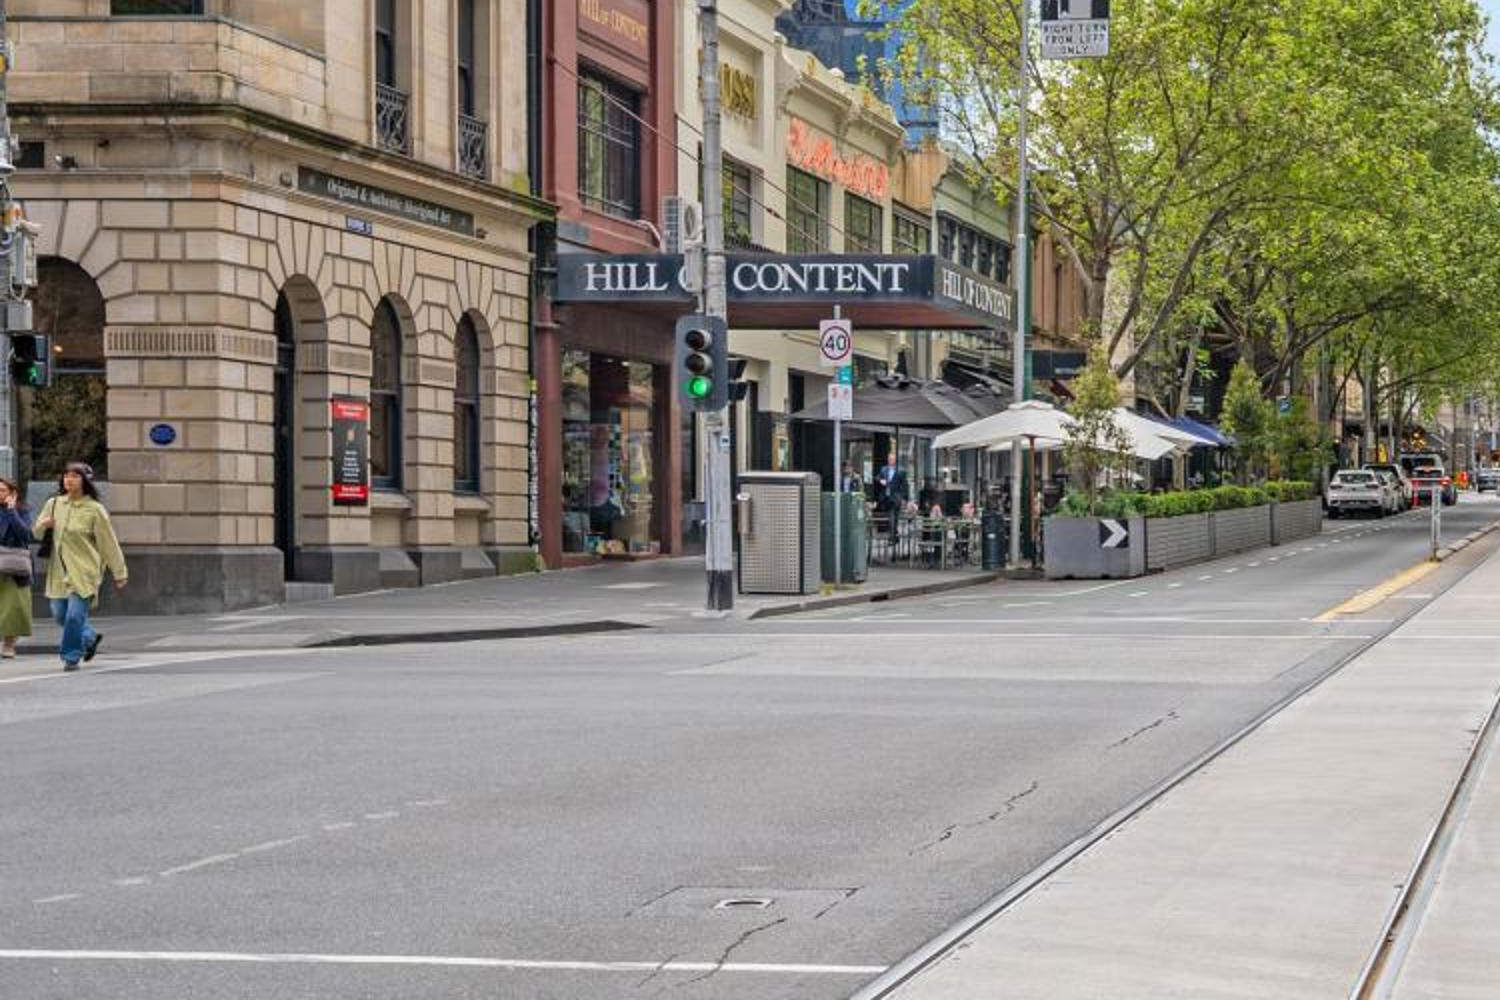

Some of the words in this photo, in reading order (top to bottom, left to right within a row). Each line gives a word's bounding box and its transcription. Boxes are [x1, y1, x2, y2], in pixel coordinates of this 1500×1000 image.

[1044, 24, 1073, 34] RIGHT
[1079, 23, 1107, 33] TURN
[1045, 34, 1073, 45] FROM
[1080, 33, 1105, 44] LEFT
[1062, 45, 1089, 55] ONLY
[584, 263, 668, 292] HILL
[733, 263, 908, 292] CONTENT
[943, 267, 963, 301] HILL
[963, 277, 975, 305] OF
[976, 283, 1011, 321] CONTENT
[825, 335, 846, 351] 40
